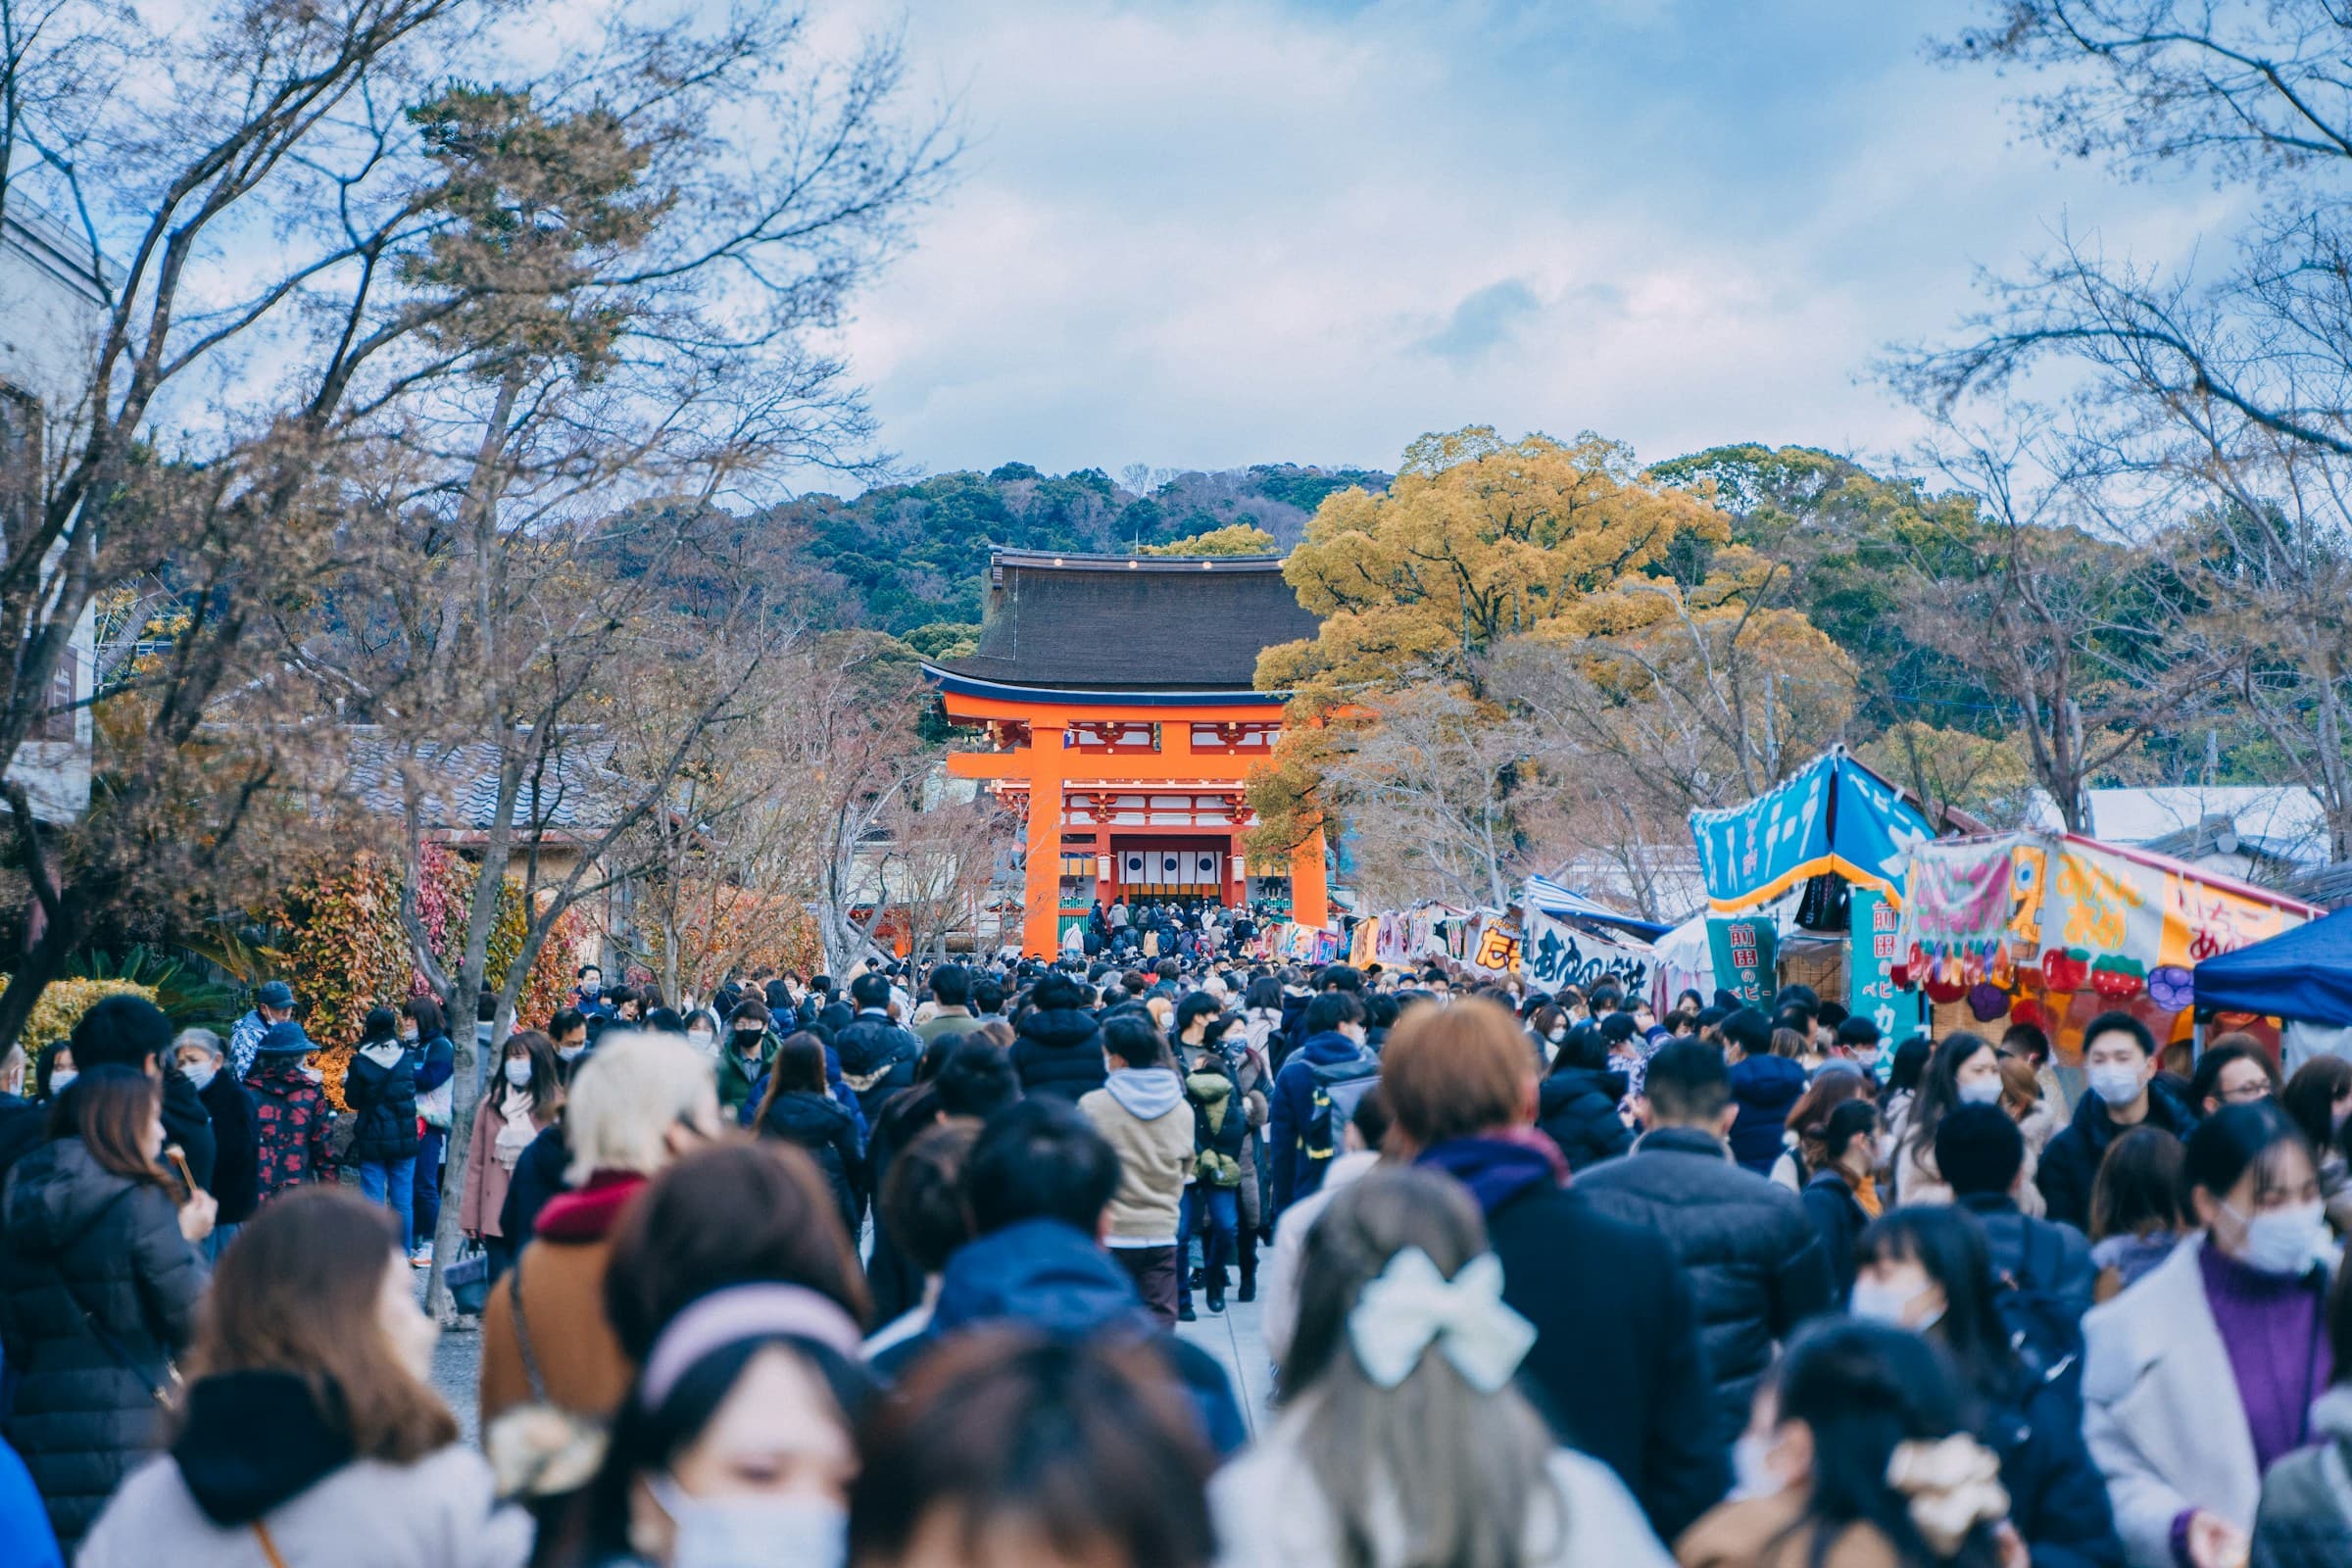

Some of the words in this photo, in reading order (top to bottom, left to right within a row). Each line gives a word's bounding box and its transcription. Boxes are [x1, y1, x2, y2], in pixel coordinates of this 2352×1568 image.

[1728, 923, 1758, 982] 前田の
[1873, 901, 1896, 977] 前田の
[1728, 983, 1772, 1001] ベビー
[1863, 981, 1906, 999] ベビー
